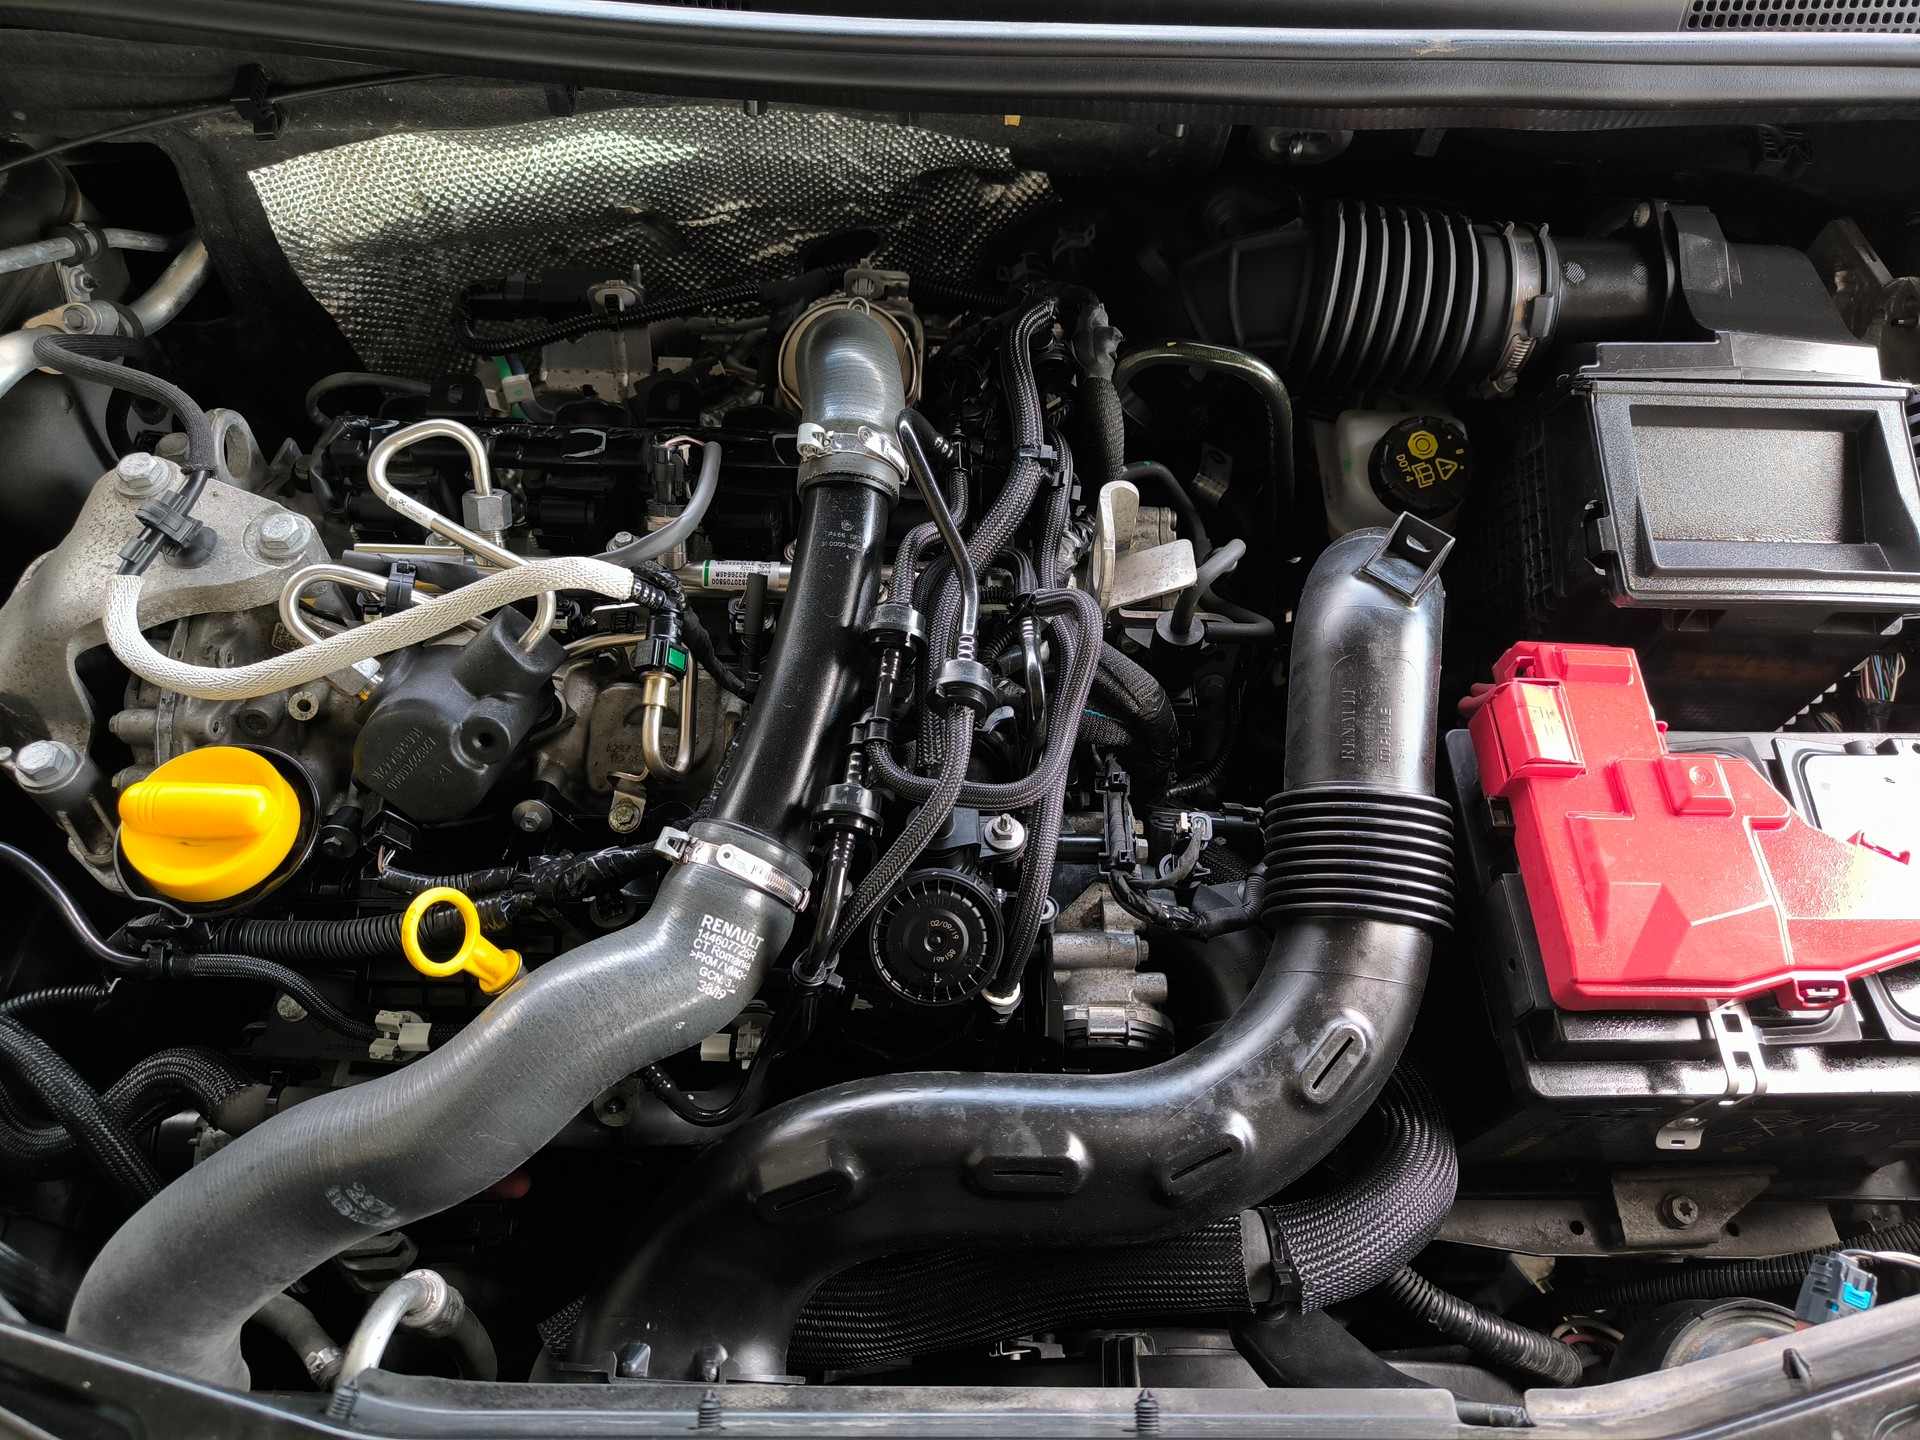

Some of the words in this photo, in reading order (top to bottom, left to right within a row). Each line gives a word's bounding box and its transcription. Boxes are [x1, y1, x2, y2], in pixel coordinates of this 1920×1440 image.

[1396, 454, 1411, 472] DOT
[1341, 686, 1356, 761] RENAULT
[1378, 707, 1392, 762] MAHLE
[698, 929, 757, 962] 144607725R
[701, 914, 765, 950] RENAULT
[930, 919, 960, 940] 02/09/19
[693, 938, 711, 952] CT
[711, 945, 751, 971] Romania
[1817, 1121, 1881, 1133] Pb
